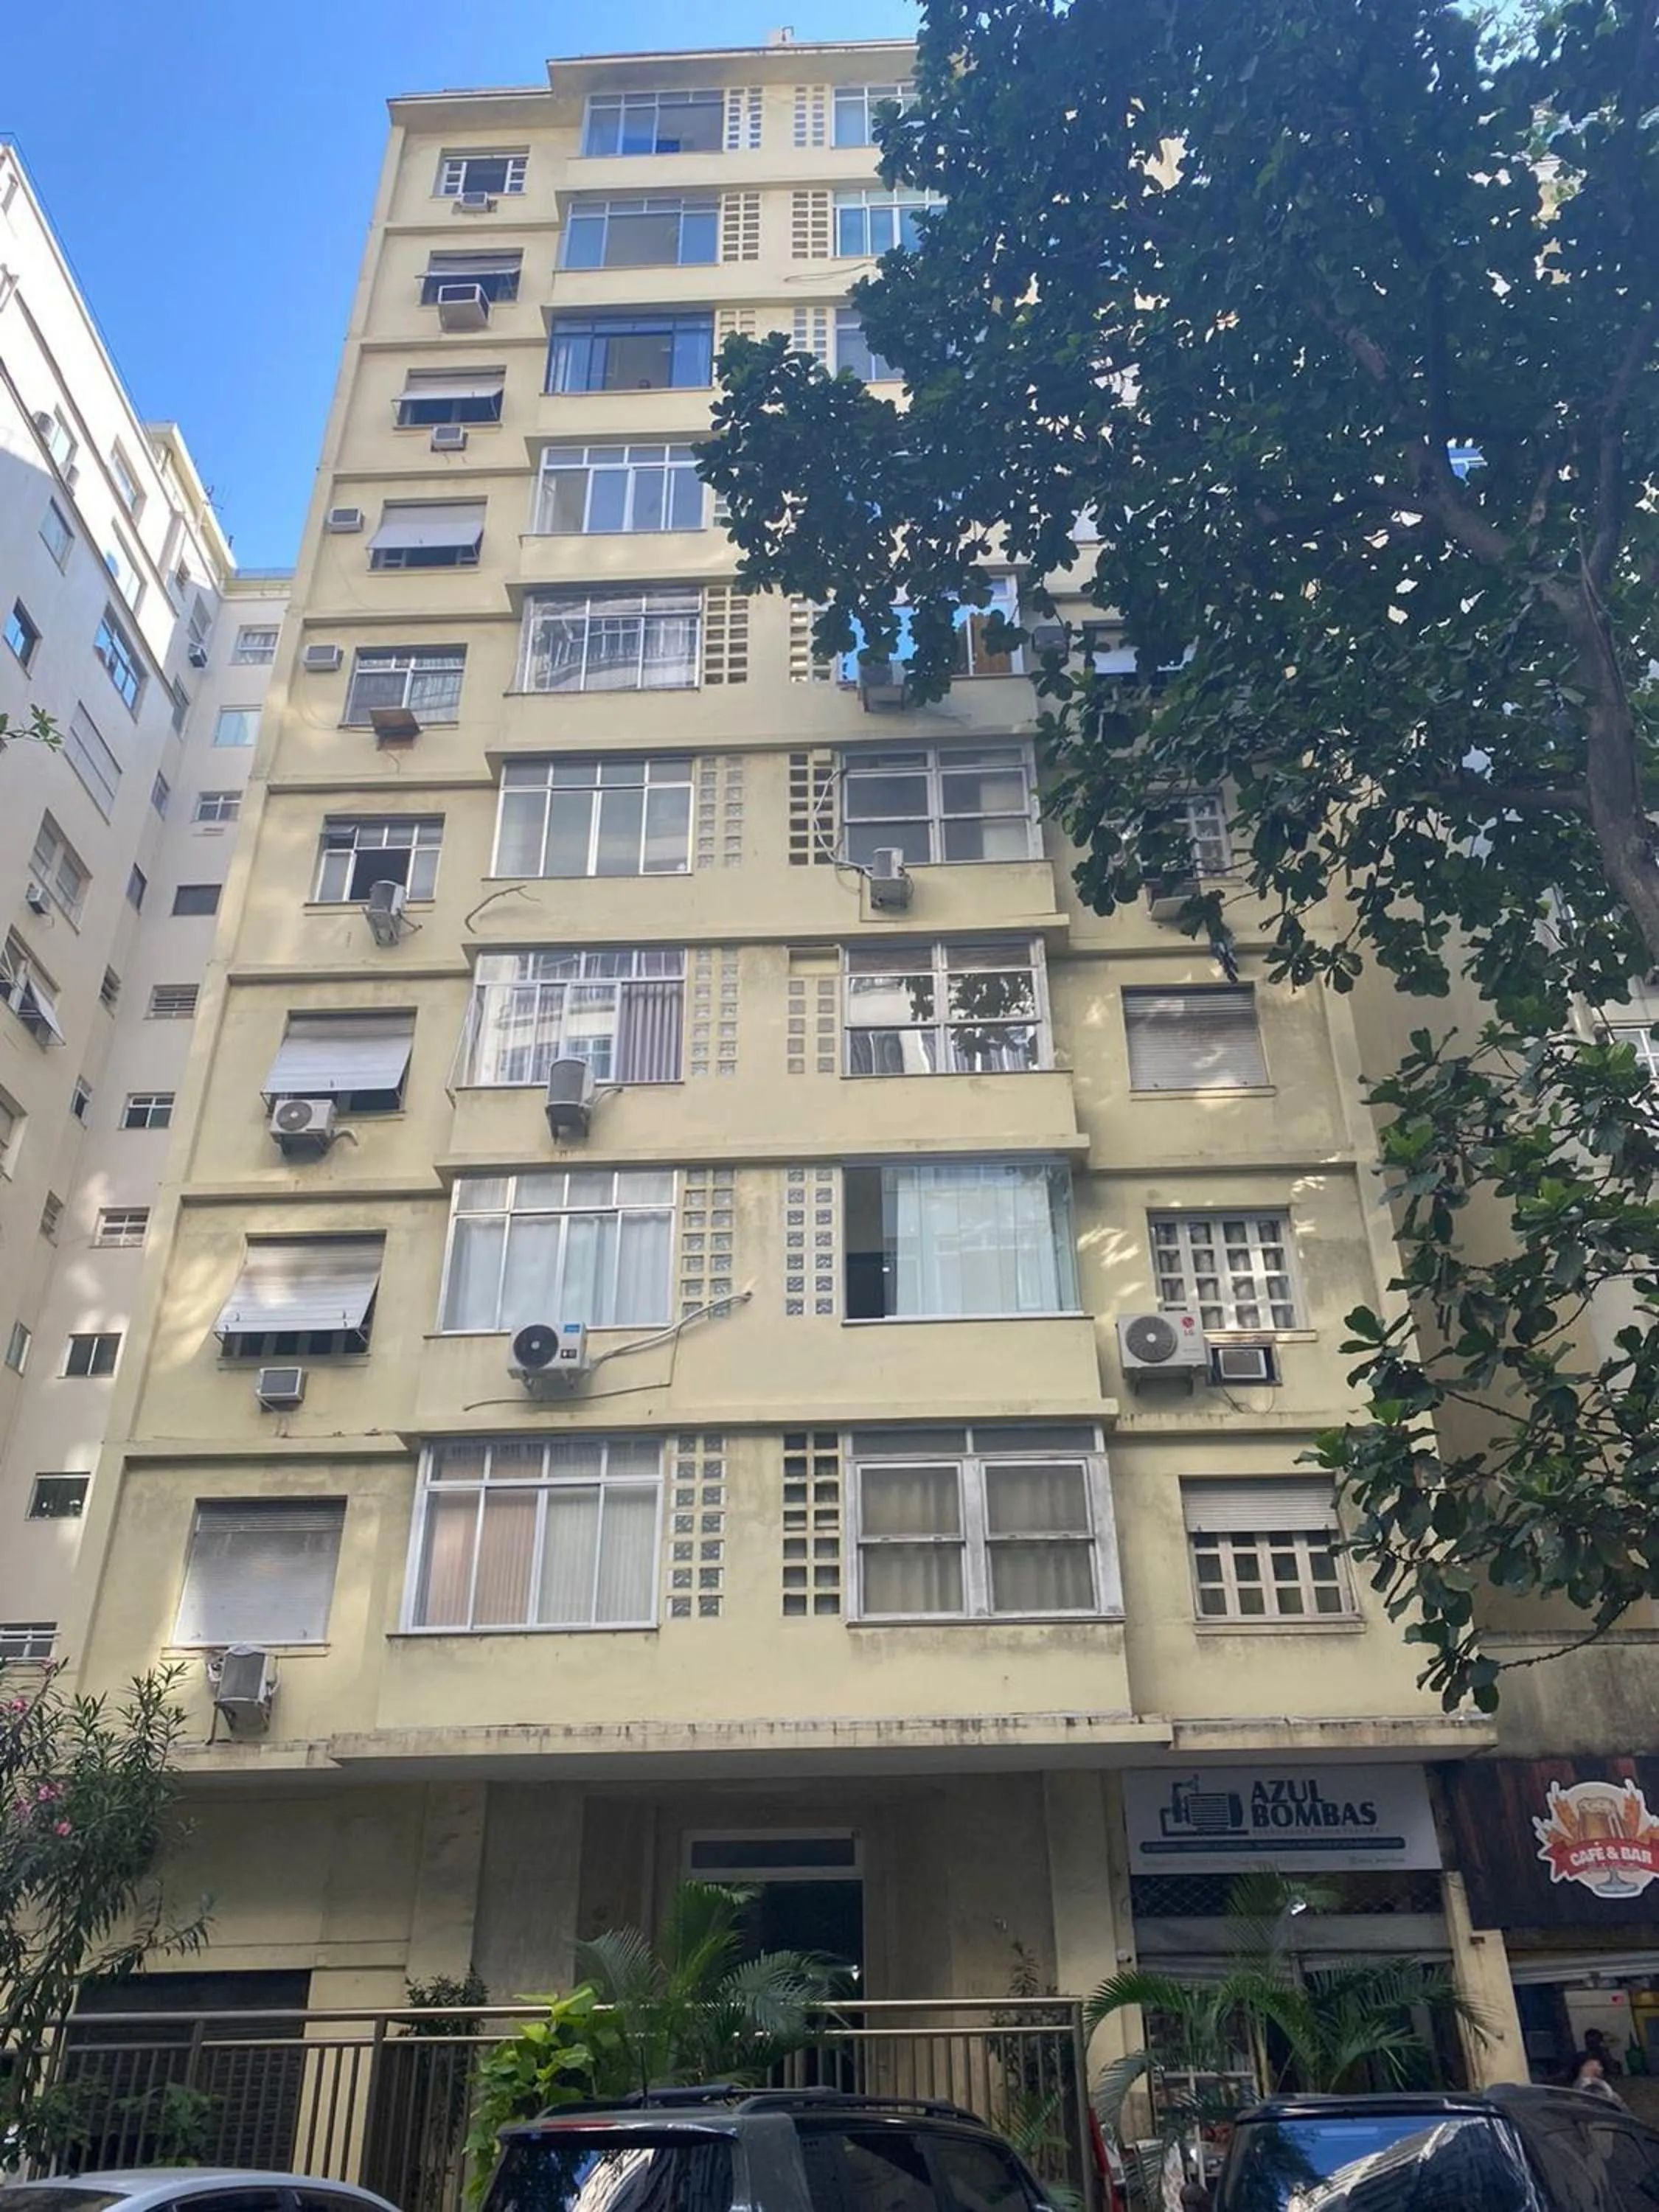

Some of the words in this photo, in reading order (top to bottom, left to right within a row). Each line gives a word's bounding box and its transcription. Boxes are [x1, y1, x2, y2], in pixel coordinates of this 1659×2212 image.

[1251, 1779, 1324, 1804] AZUL
[1251, 1801, 1378, 1827] BOMBAS
[1606, 1846, 1619, 1860] &
[1621, 1846, 1653, 1865] BAR
